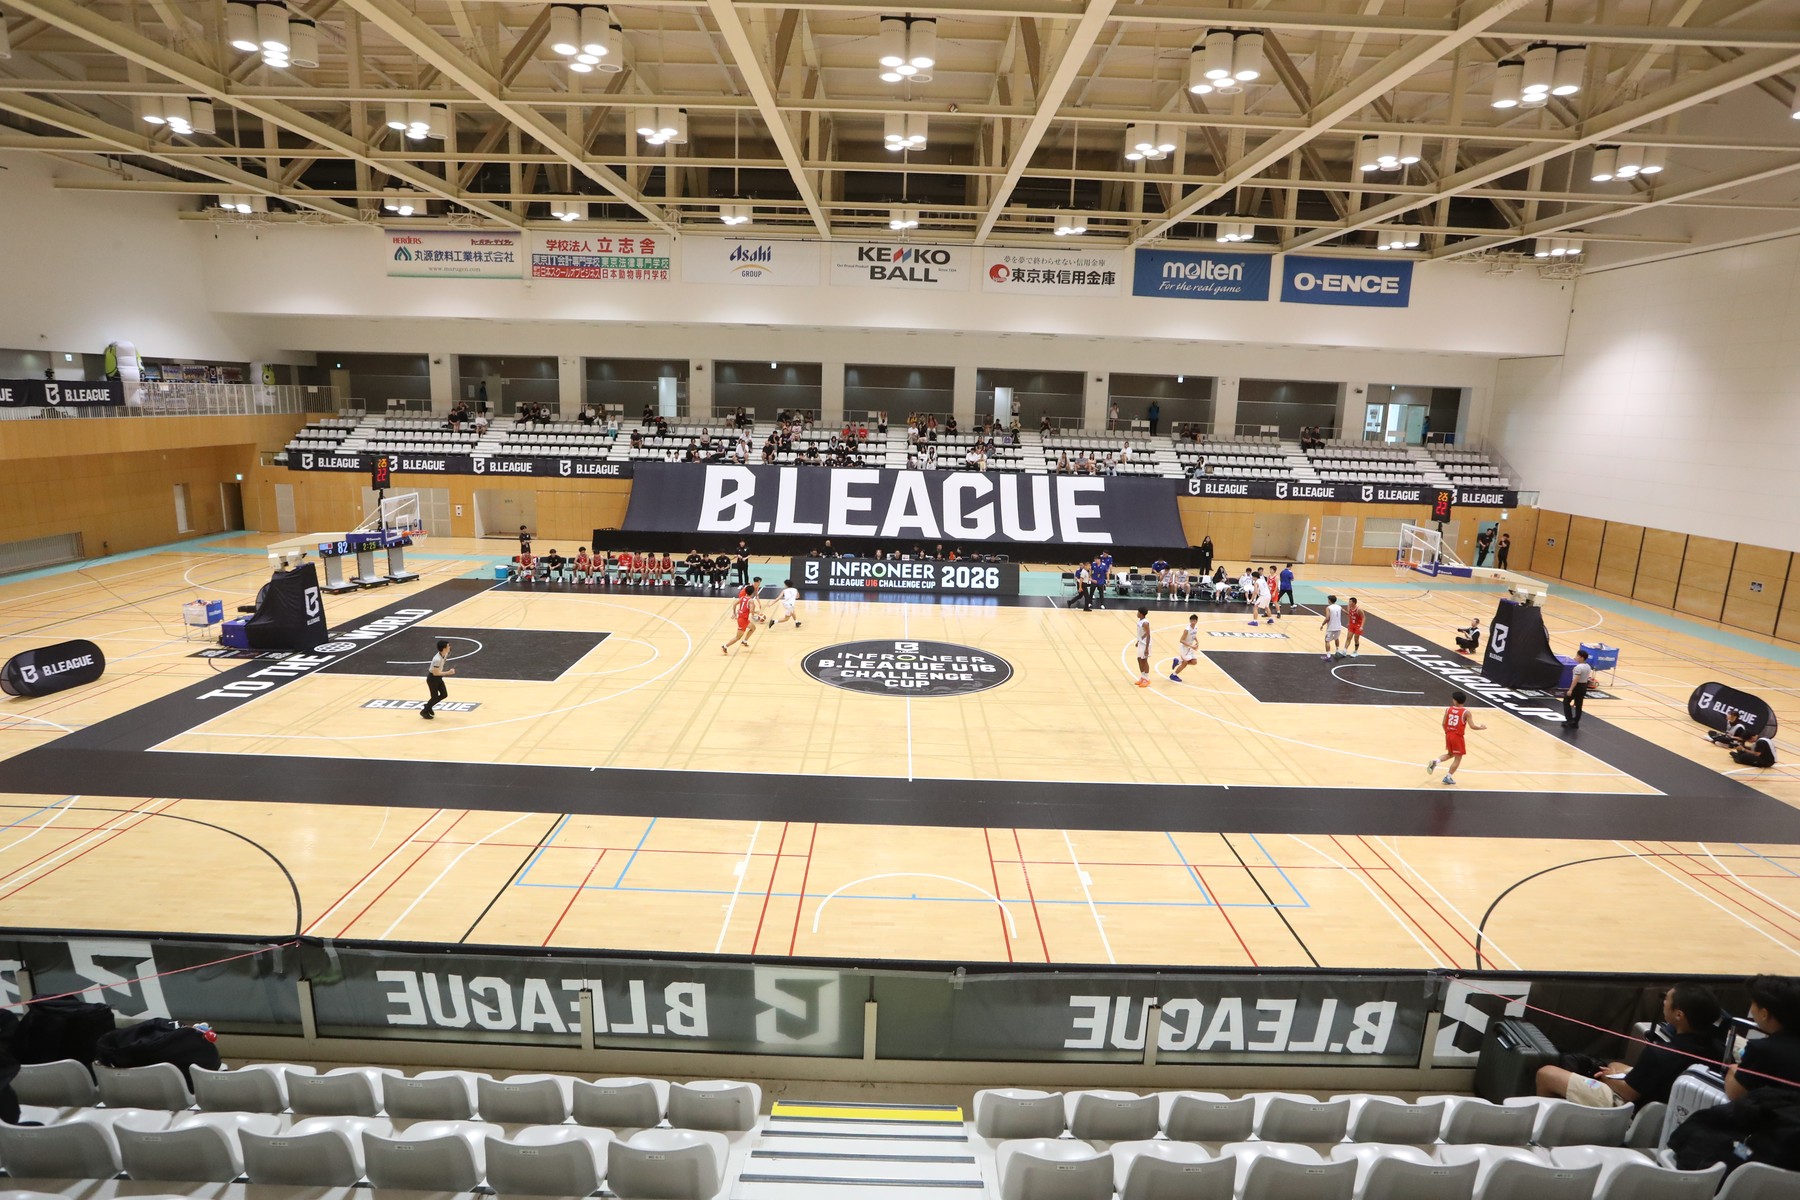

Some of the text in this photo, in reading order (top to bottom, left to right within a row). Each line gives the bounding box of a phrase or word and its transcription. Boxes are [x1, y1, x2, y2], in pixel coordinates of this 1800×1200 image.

[546, 236, 656, 255] 学校法人 立志舎
[414, 249, 515, 263] 丸源飲料工業株式会社
[729, 244, 772, 262] Asahi
[857, 246, 951, 265] KENKO
[601, 257, 669, 270] 東京法律専門学校
[1003, 255, 1107, 267] 夢を夢で終わらせない信用金庫
[602, 268, 668, 281] 日本動物専門学校
[741, 270, 762, 278] GROUP
[869, 265, 938, 283] BALL
[1011, 267, 1116, 286] 東京東信用金庫
[1162, 259, 1243, 281] molten
[1159, 281, 1242, 296] For the real game
[1293, 272, 1400, 294] O-ENCE
[64, 388, 111, 402] B.LEAGUE
[318, 456, 360, 469] B.LEAGUE
[402, 458, 446, 472] B.LEAGUE
[489, 460, 533, 474] B.LEAGUE
[576, 463, 620, 476] B.LEAGUE
[1204, 483, 1249, 495] B.LEAGUE
[1291, 486, 1336, 499] B.LEAGUE
[1377, 489, 1421, 502] B.LEAGUE
[698, 464, 1114, 543] B.LEAGUE
[1461, 492, 1505, 505] B.LEAGUE
[337, 541, 348, 554] 82
[830, 561, 935, 579] INFRONEER
[829, 578, 865, 587] B.LEAGUE
[865, 578, 878, 588] U16
[878, 578, 921, 589] CHALLENGE
[921, 580, 936, 589] CUP
[941, 565, 1000, 590] 2026
[195, 607, 434, 700] TO THE WORLD
[836, 652, 987, 664] INFRONEER
[41, 653, 95, 677] B.LEAGUE
[818, 658, 997, 673] B.LEAGUE U16
[840, 670, 975, 681] CHALLENGE
[884, 679, 931, 689] CUP
[1387, 644, 1568, 722] B.LEAGUE.JP
[1448, 713, 1459, 726] 23
